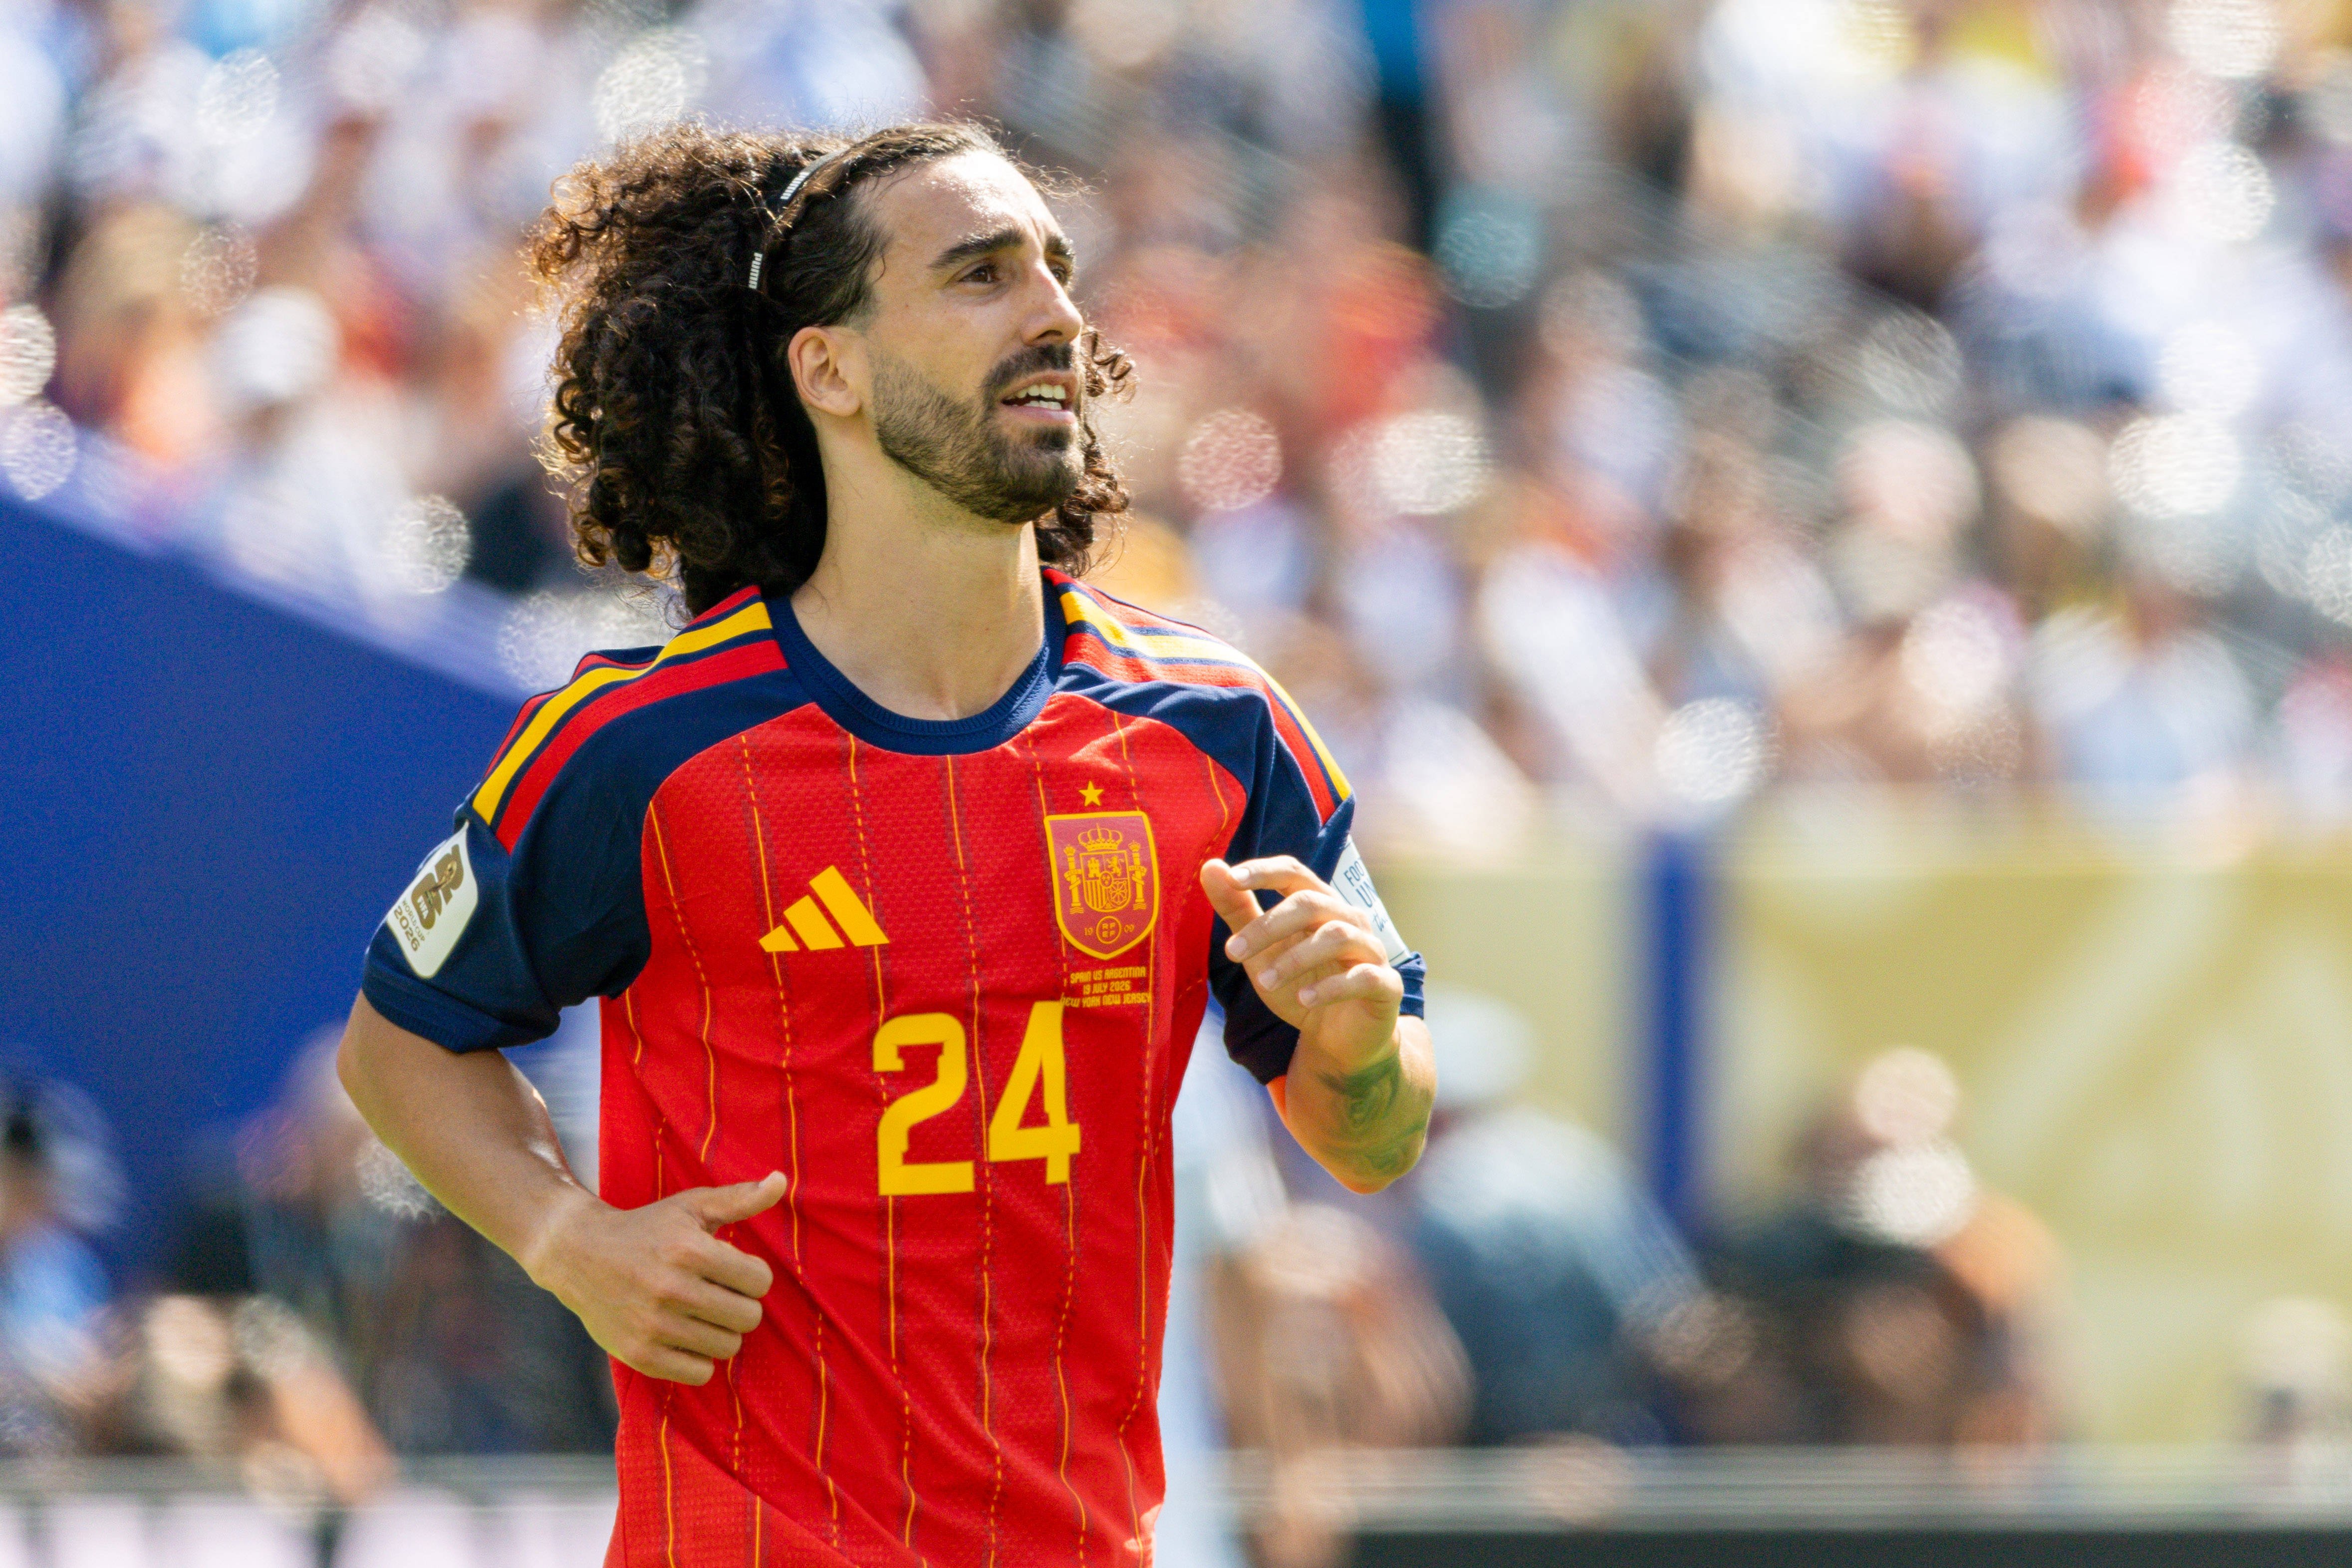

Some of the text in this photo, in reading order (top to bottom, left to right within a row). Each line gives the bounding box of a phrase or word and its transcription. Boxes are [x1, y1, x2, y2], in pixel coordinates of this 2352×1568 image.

[748, 251, 763, 290] PUMA
[394, 905, 420, 952] 2026
[415, 926, 425, 941] CUP
[1069, 971, 1091, 984] SPAIN
[1104, 966, 1147, 980] ARGENTINA
[1082, 980, 1131, 995] 19 JULY 2026
[1082, 995, 1101, 1008] YORK
[1102, 994, 1121, 1006] NEW
[1123, 992, 1151, 1004] JERSEY
[872, 1000, 1081, 1196] 24
